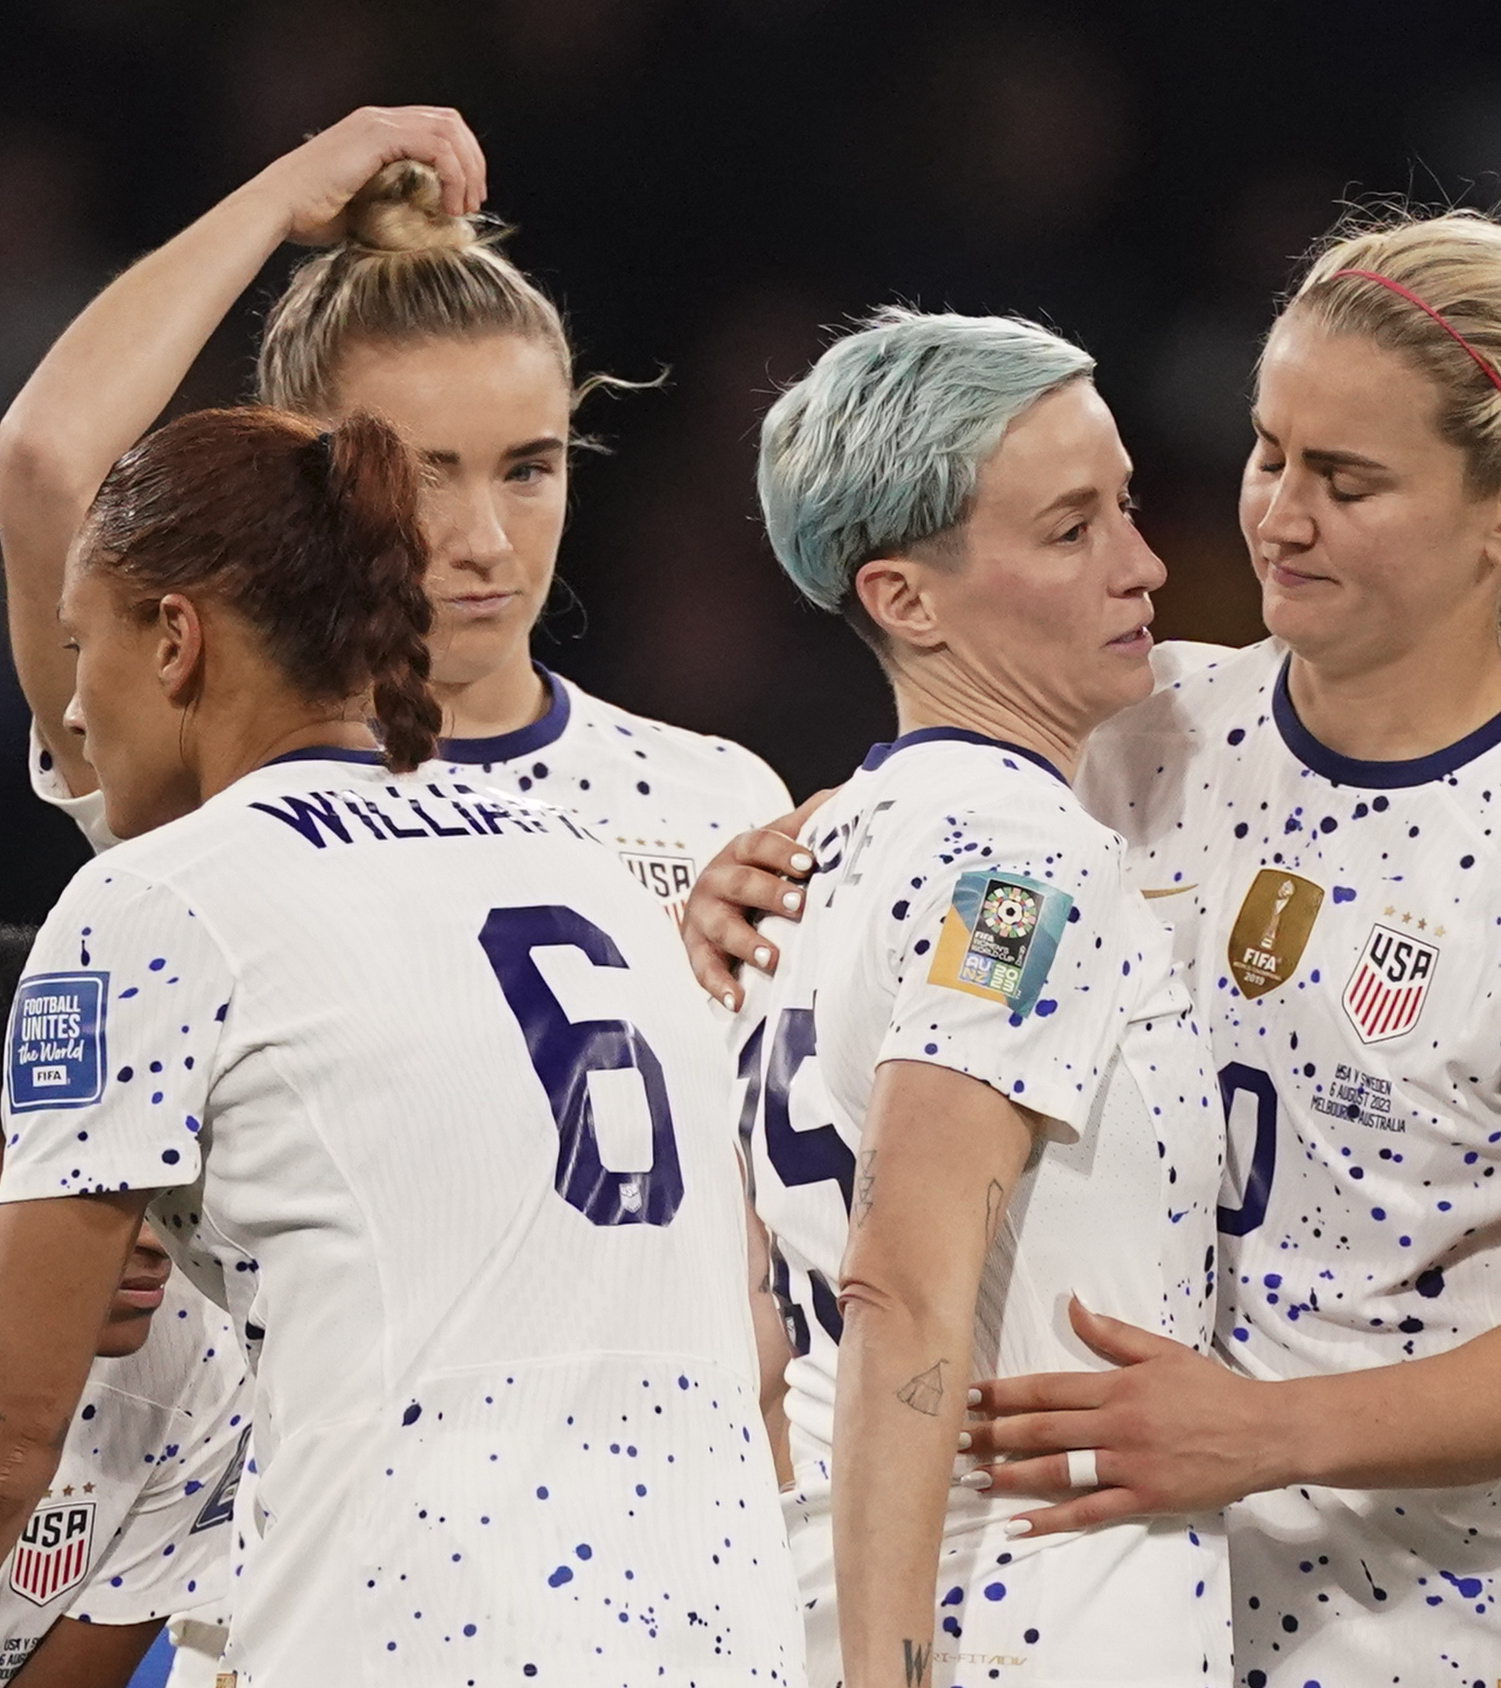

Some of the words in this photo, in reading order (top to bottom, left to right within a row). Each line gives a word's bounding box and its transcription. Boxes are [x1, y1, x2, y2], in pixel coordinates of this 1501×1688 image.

[248, 783, 602, 849] WILLIA
[974, 931, 995, 943] FIFA
[965, 956, 992, 972] AU
[1242, 947, 1277, 973] FIFA
[1369, 931, 1433, 983] USA
[962, 968, 988, 983] NZ
[1243, 972, 1266, 986] 2019
[23, 995, 81, 1016] FOOTBALL
[21, 1014, 80, 1041] UNITES
[18, 1043, 39, 1065] the
[40, 1039, 85, 1062] World
[36, 1071, 62, 1082] FIFA
[477, 904, 684, 1227] 6
[1335, 1063, 1352, 1082] USA
[1360, 1072, 1393, 1096] SWEDEN
[1329, 1082, 1337, 1097] 6
[1336, 1084, 1370, 1107] AUGUST
[1370, 1094, 1392, 1114] 2023
[1357, 1110, 1406, 1133] AUSTRALIA
[1216, 1061, 1277, 1236] 0
[21, 1509, 88, 1548] USA
[3, 1638, 21, 1652] USA
[23, 1637, 31, 1650] V
[8, 1652, 26, 1665] AUG
